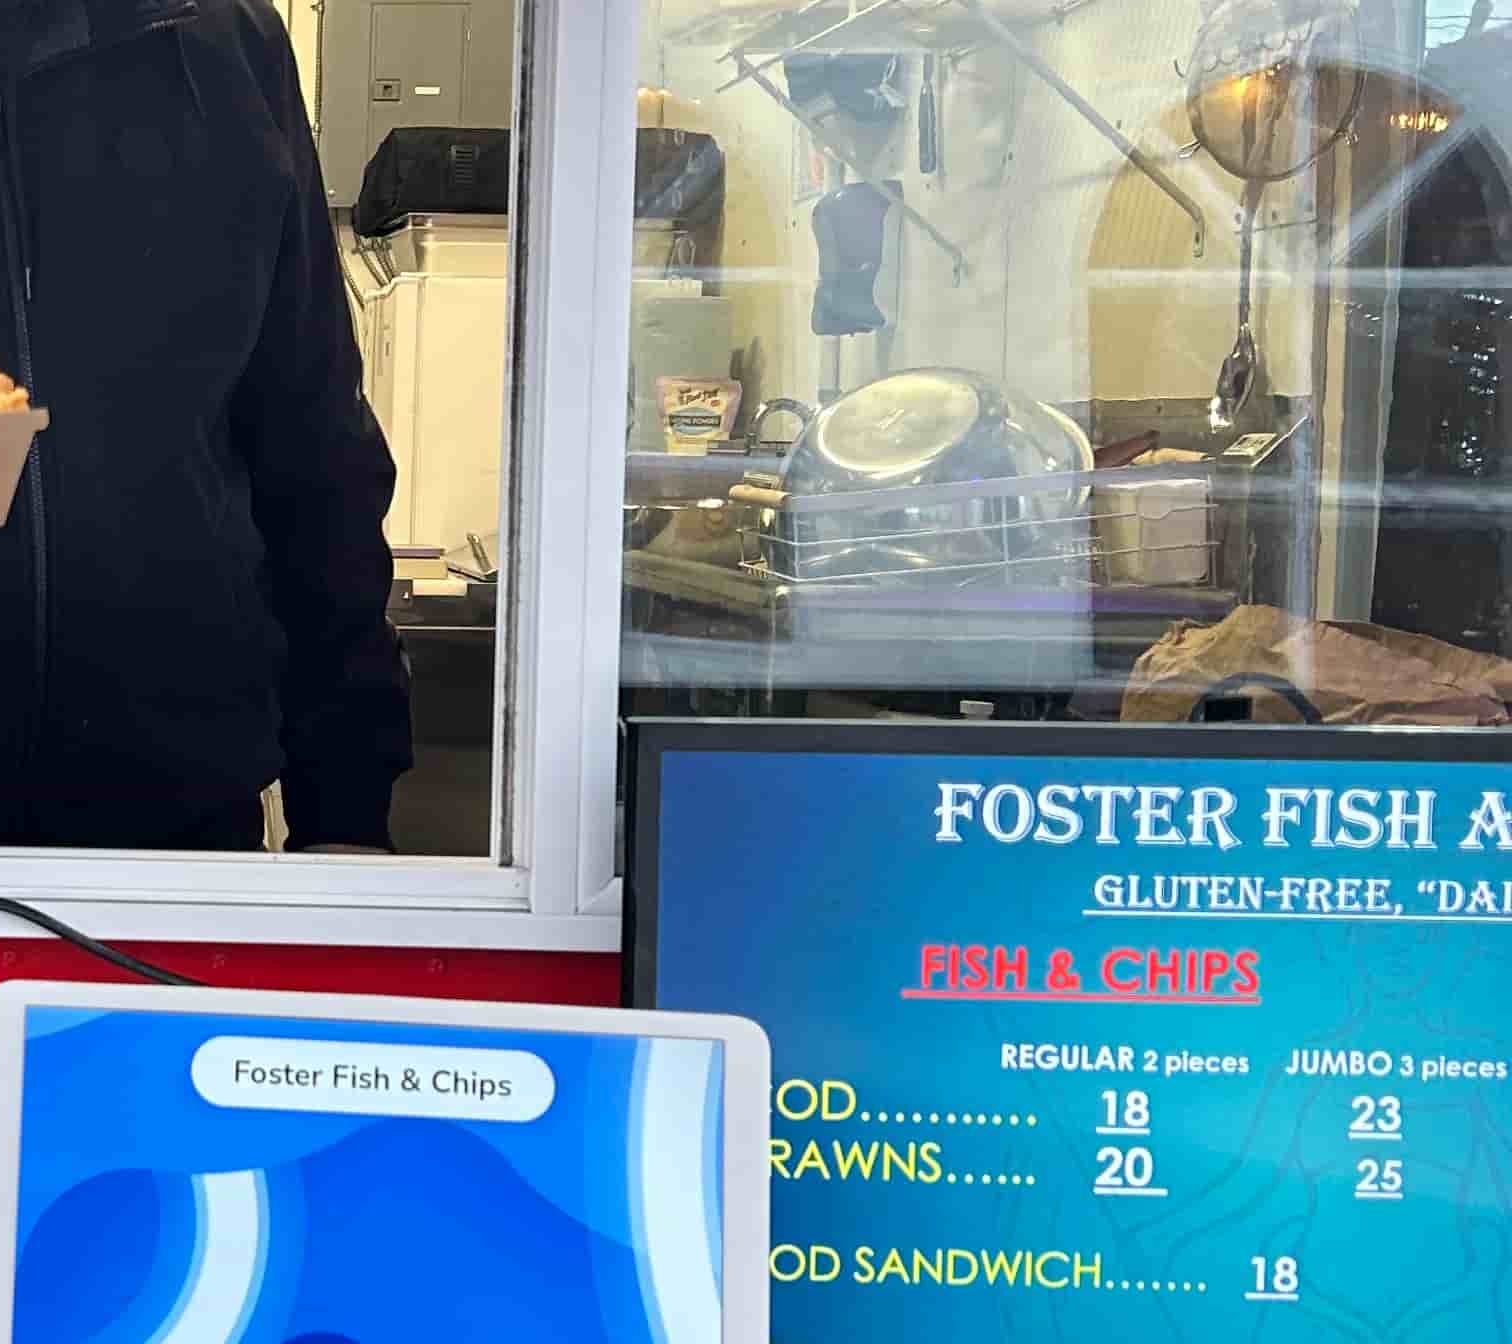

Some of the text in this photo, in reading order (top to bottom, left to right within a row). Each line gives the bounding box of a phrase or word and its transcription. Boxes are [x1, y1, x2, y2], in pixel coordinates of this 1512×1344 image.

[934, 782, 1242, 851] FOSTER
[1262, 787, 1438, 850] FISH
[1094, 875, 1404, 916] GLUTEN-FREE,
[921, 945, 1260, 994] FISH & CHIPS
[234, 1059, 512, 1101] Foster Fish & Chips
[1001, 1043, 1508, 1081] REGULAR 2 pieces JUMBO 3 pieces
[1102, 1089, 1150, 1127] 18
[1350, 1095, 1402, 1131] 23
[1095, 1147, 1153, 1186] 20
[1356, 1159, 1403, 1192] 25
[769, 1244, 841, 1282] OD
[1250, 1256, 1299, 1292] 18
